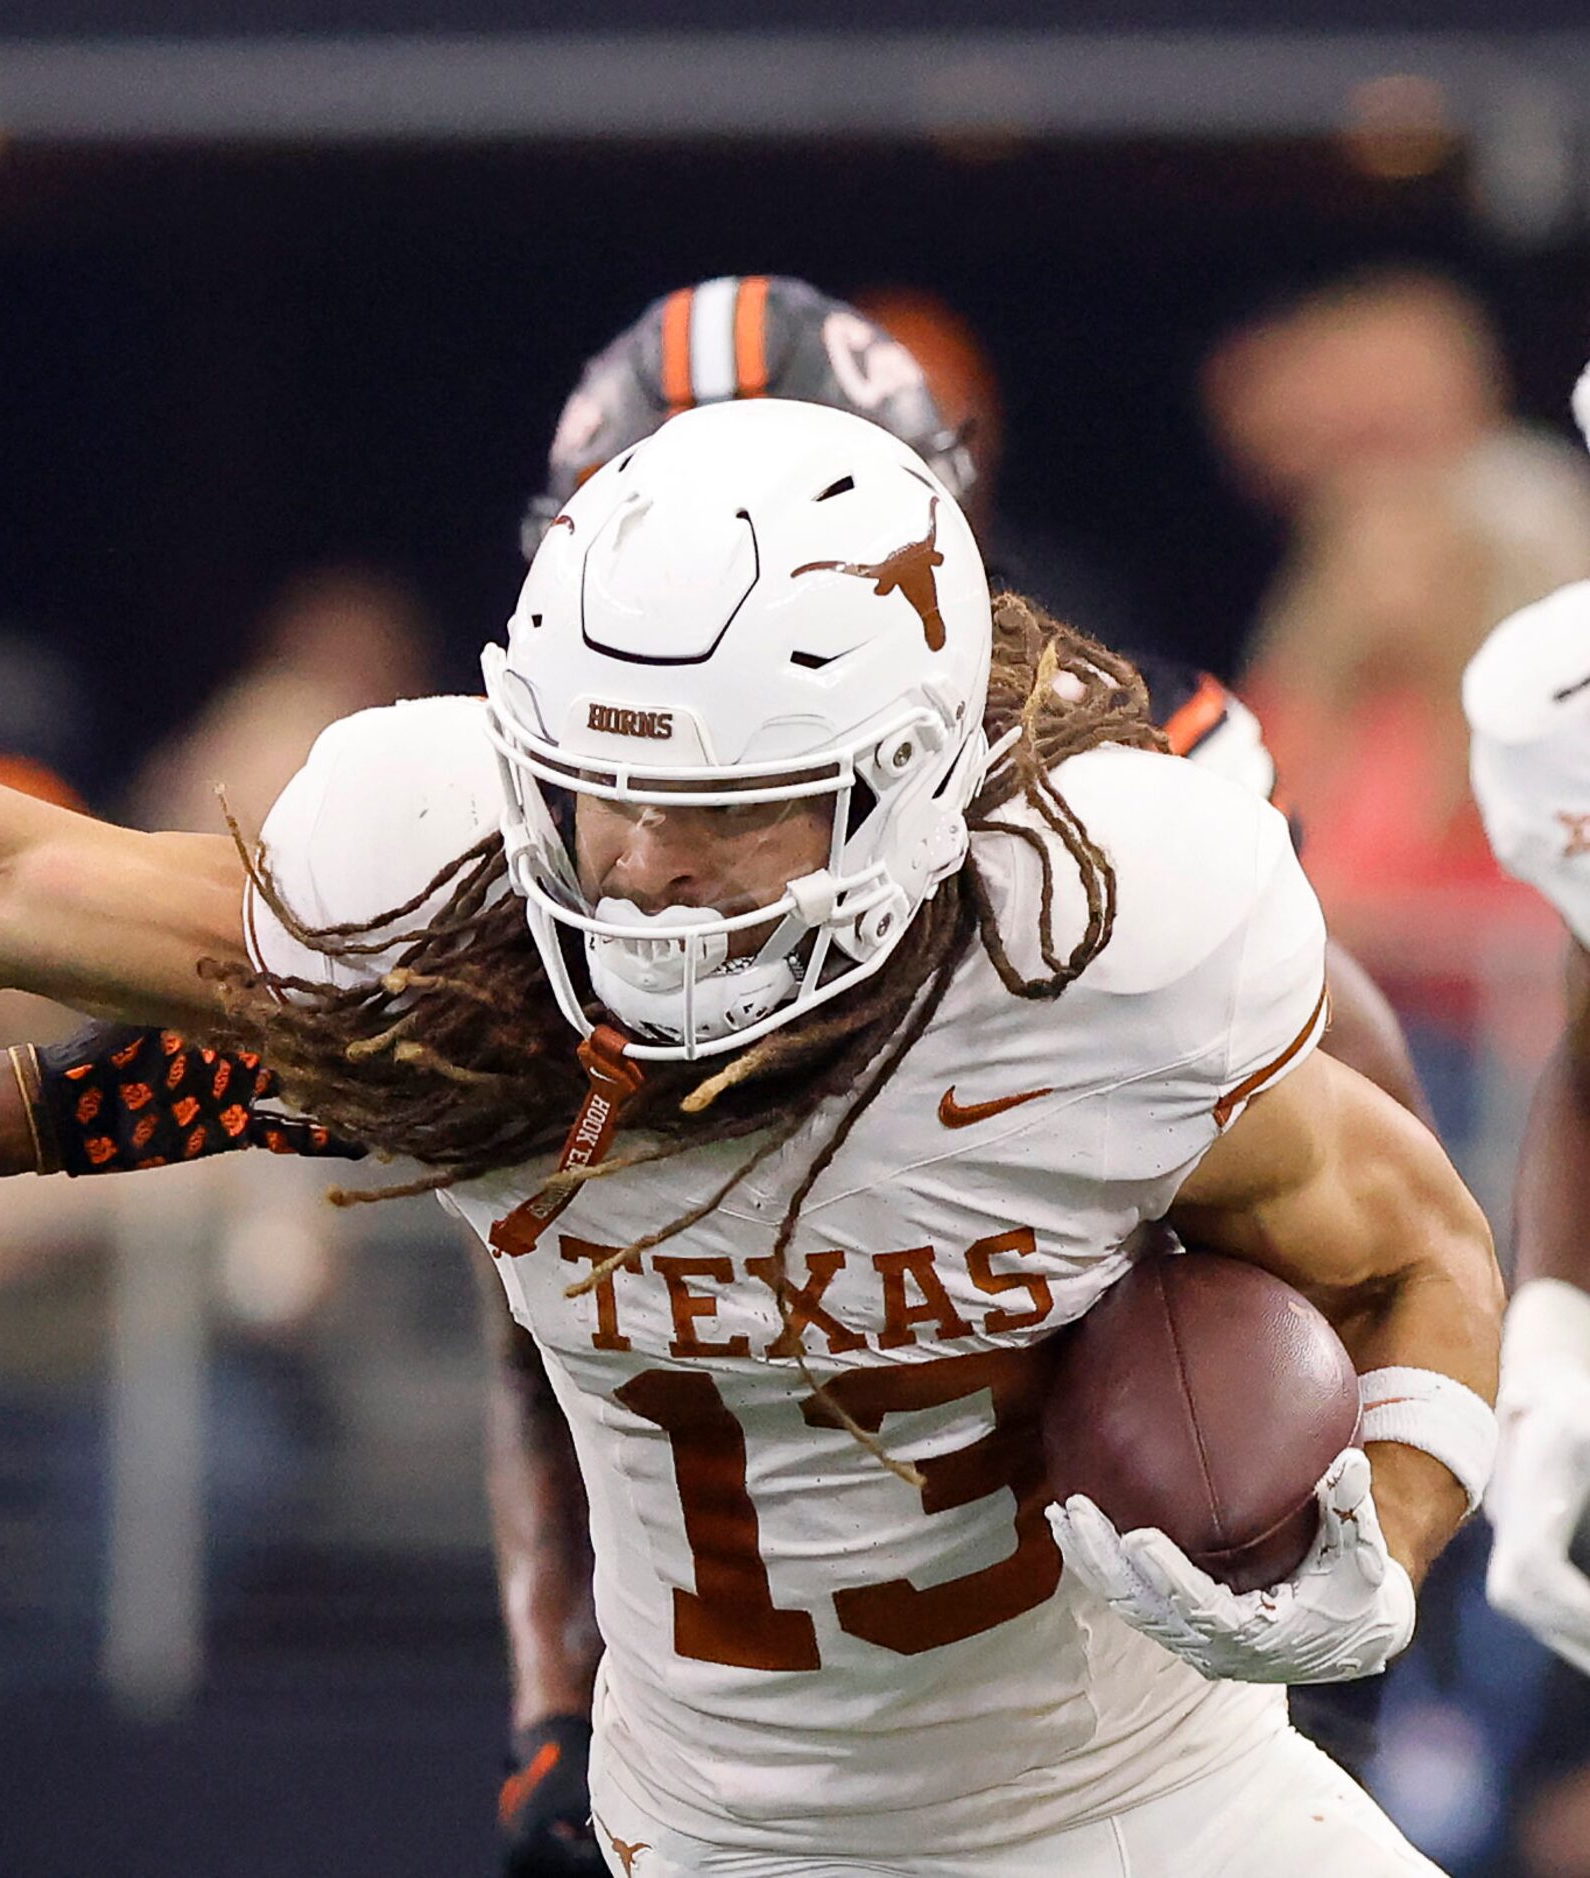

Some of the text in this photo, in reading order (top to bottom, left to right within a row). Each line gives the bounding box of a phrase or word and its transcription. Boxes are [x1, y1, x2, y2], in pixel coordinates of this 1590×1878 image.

[587, 703, 673, 740] HORNS
[576, 1093, 611, 1148] HOOK
[558, 1226, 1055, 1358] TEXAS
[614, 1343, 1066, 1672] 13
